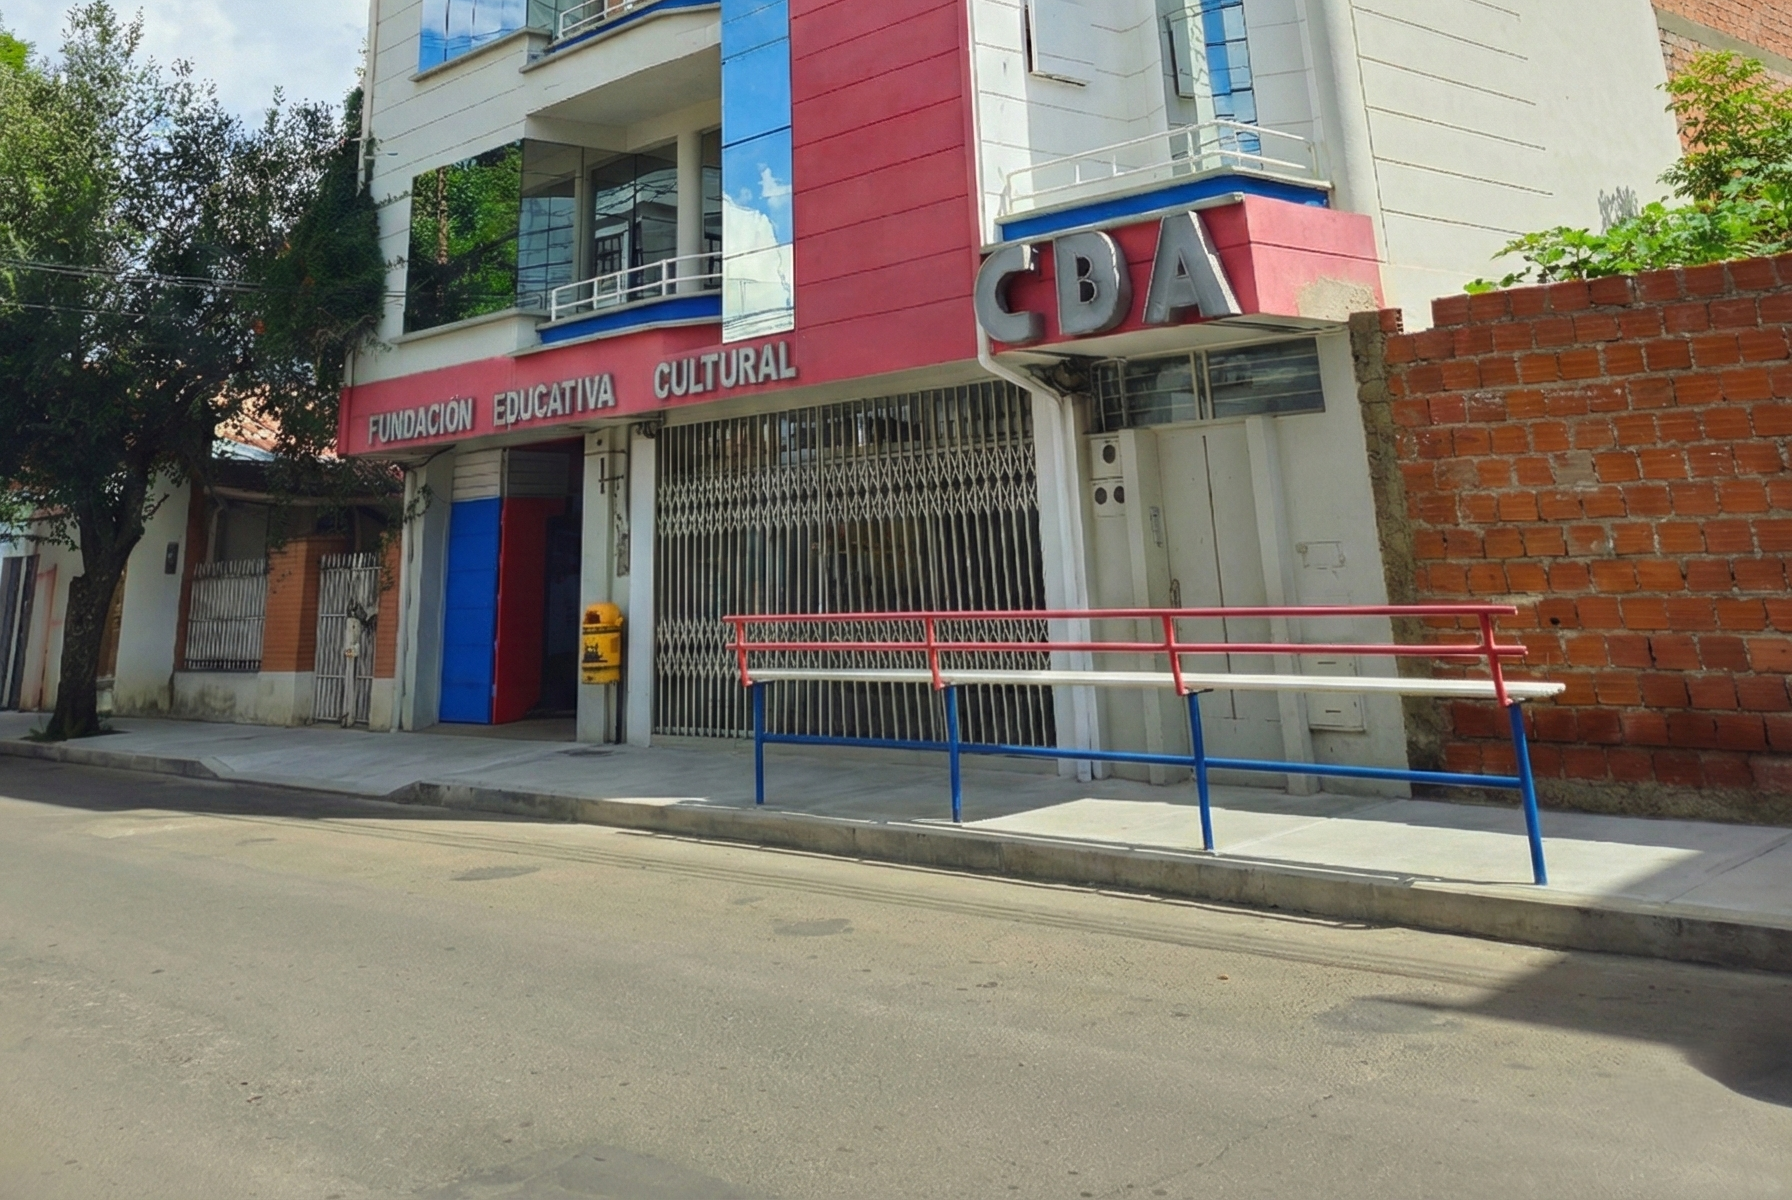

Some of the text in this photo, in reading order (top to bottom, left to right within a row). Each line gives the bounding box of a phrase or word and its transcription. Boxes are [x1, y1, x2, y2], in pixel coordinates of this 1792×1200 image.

[974, 210, 1243, 343] CBA
[367, 341, 797, 445] FUNDACIÓN EDUCATIVA CULTURAL
